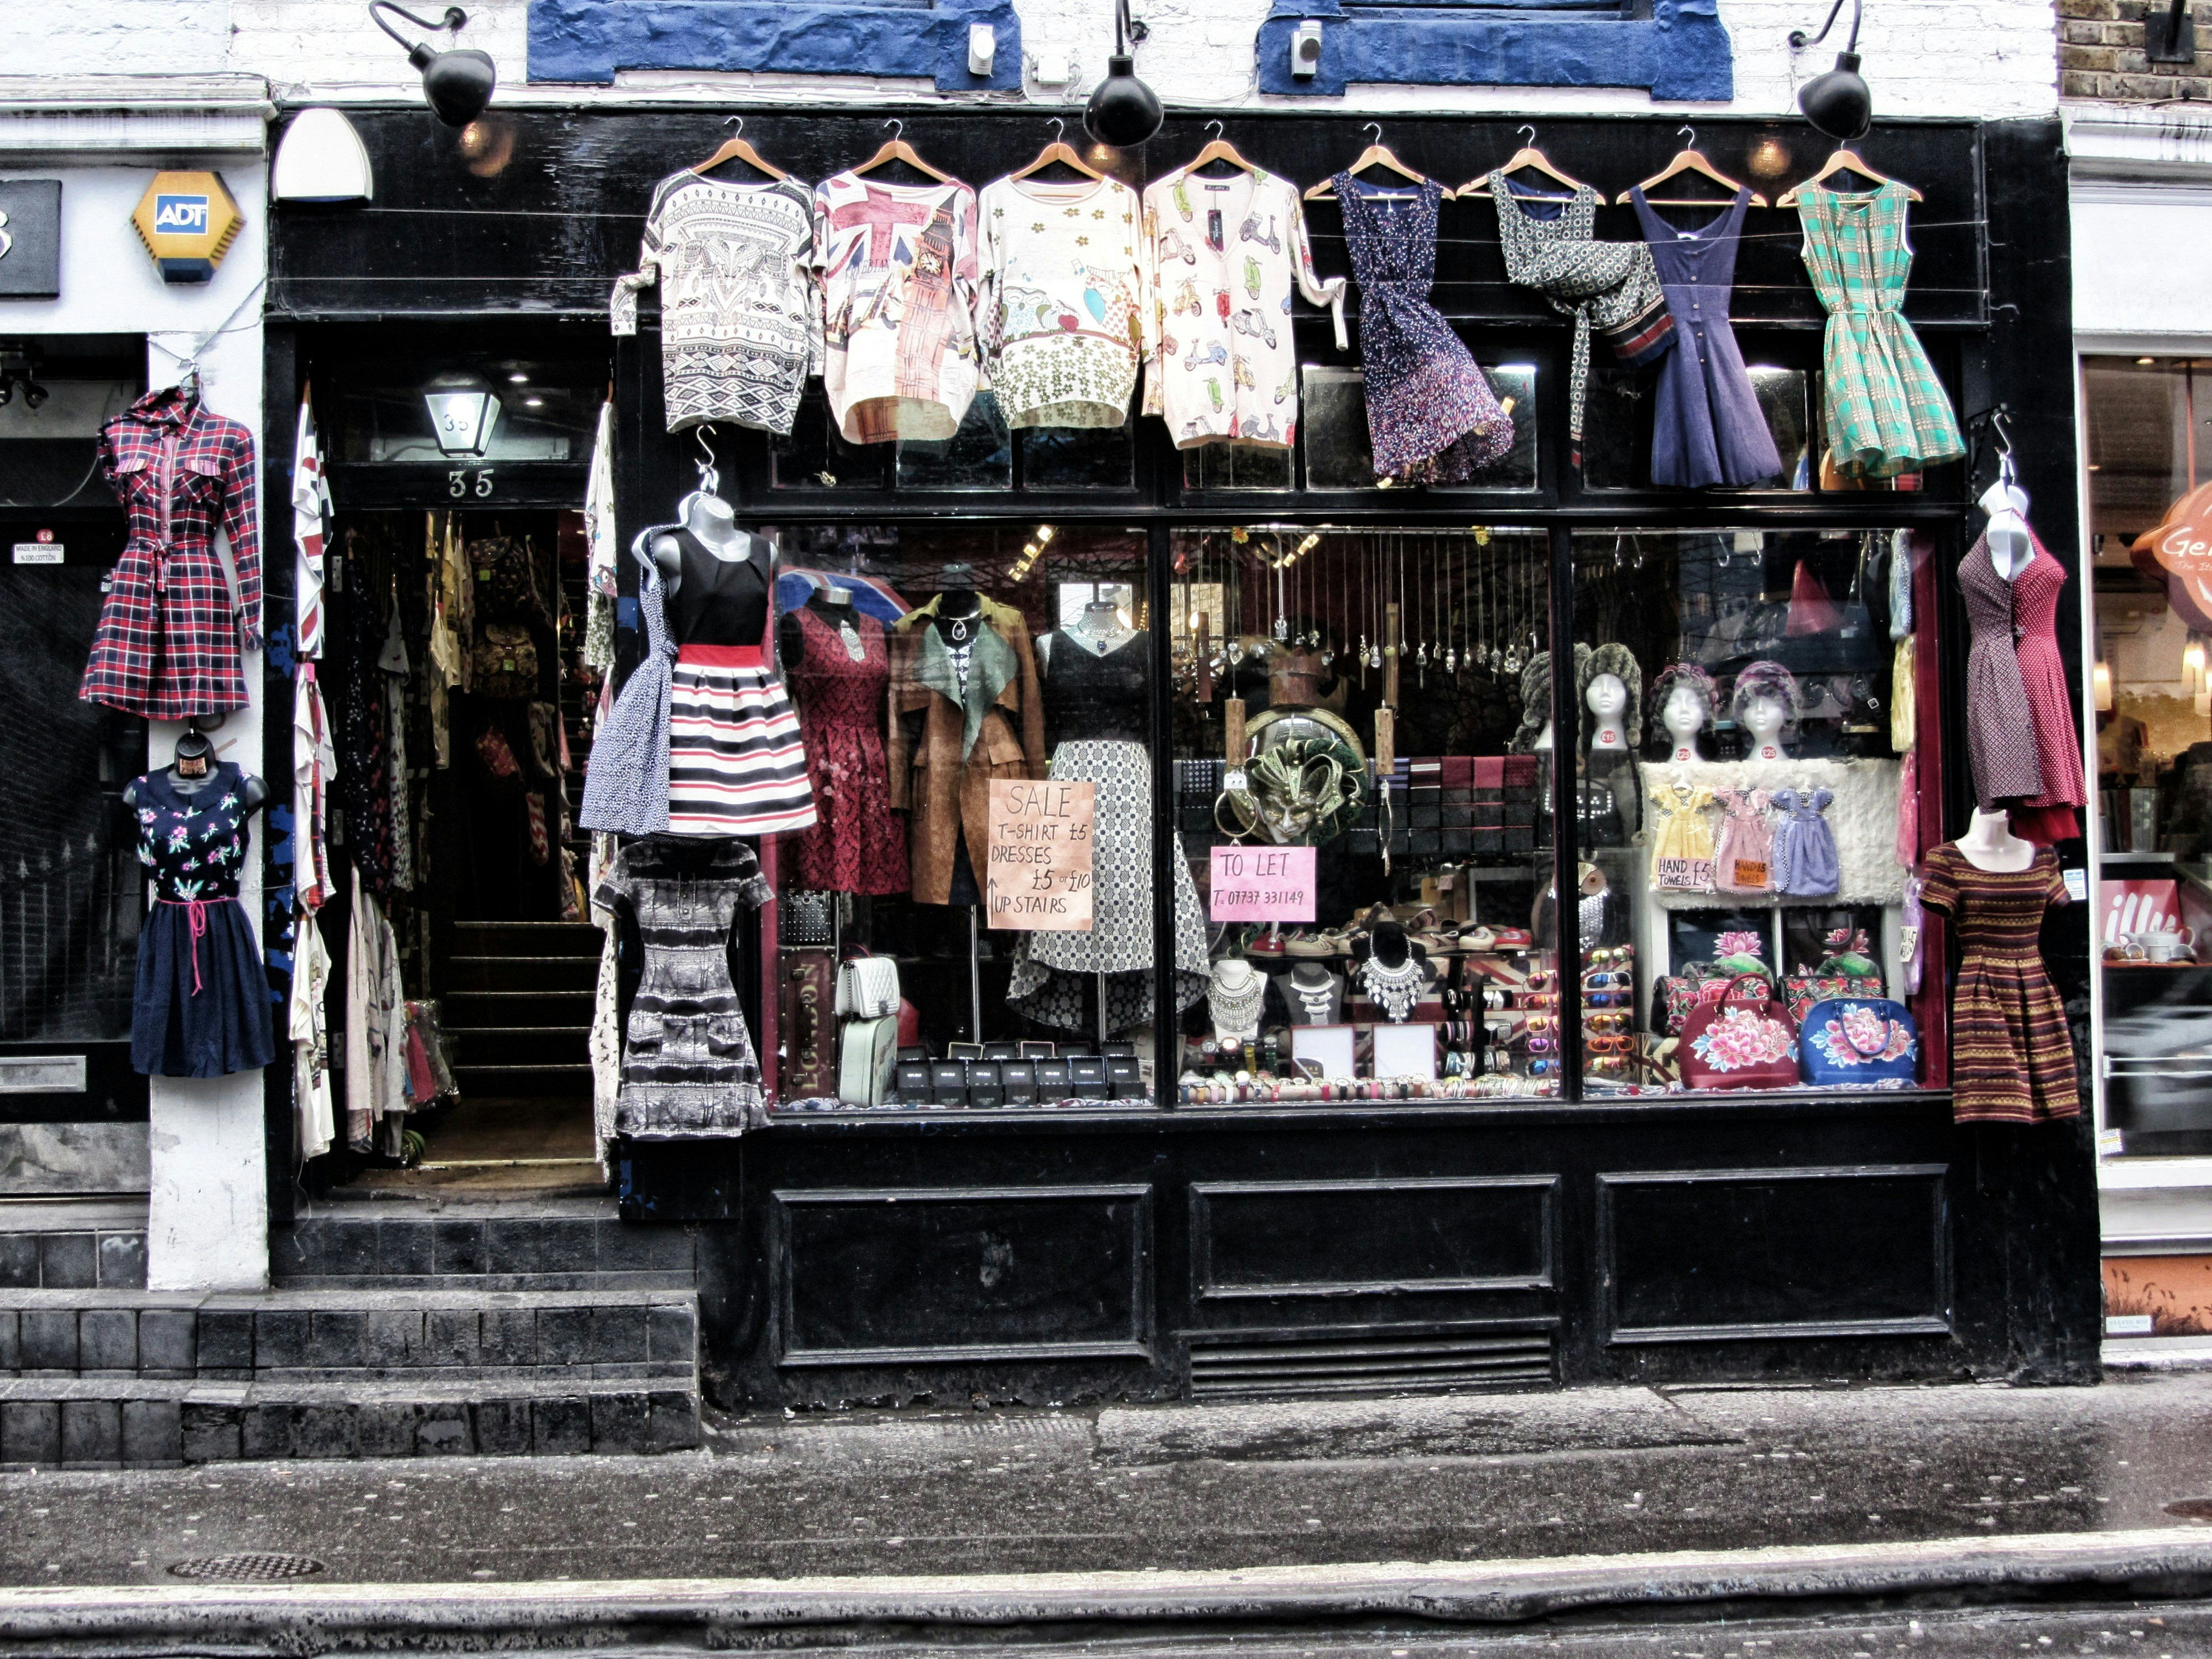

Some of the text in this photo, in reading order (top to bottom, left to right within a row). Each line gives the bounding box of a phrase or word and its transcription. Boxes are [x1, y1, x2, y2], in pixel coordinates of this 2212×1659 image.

[156, 204, 207, 226] ADT
[450, 469, 493, 498] 35
[41, 531, 52, 541] £8
[1006, 786, 1071, 817] SALE
[998, 823, 1088, 841] T-SHIRT £5
[992, 846, 1052, 865] DRESSES
[1220, 853, 1290, 876] TO LET
[1659, 859, 1687, 873] HAND
[1693, 862, 1710, 886] £5
[1032, 869, 1054, 890] £5
[1068, 870, 1091, 892] £10
[1658, 874, 1691, 886] TOWELS
[1228, 891, 1260, 905] 07737
[1264, 890, 1304, 905] 331149
